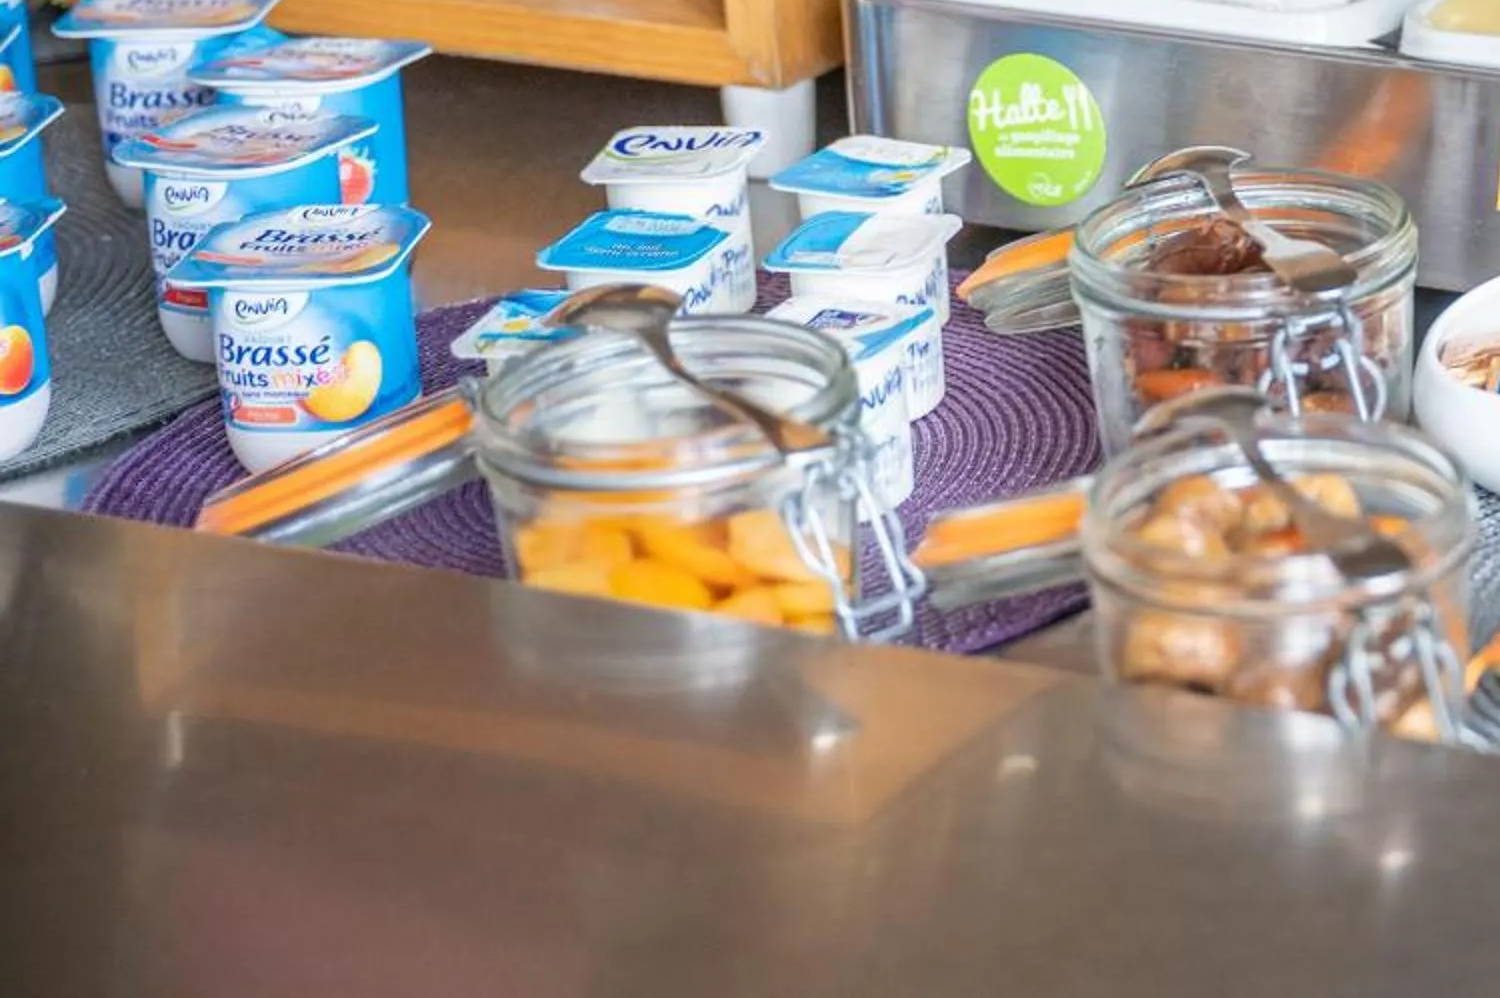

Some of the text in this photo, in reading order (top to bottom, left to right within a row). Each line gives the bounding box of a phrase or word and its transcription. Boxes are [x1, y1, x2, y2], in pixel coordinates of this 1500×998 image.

[970, 82, 1066, 131] Halte
[153, 218, 197, 251] Bra
[219, 333, 332, 367] Brassé
